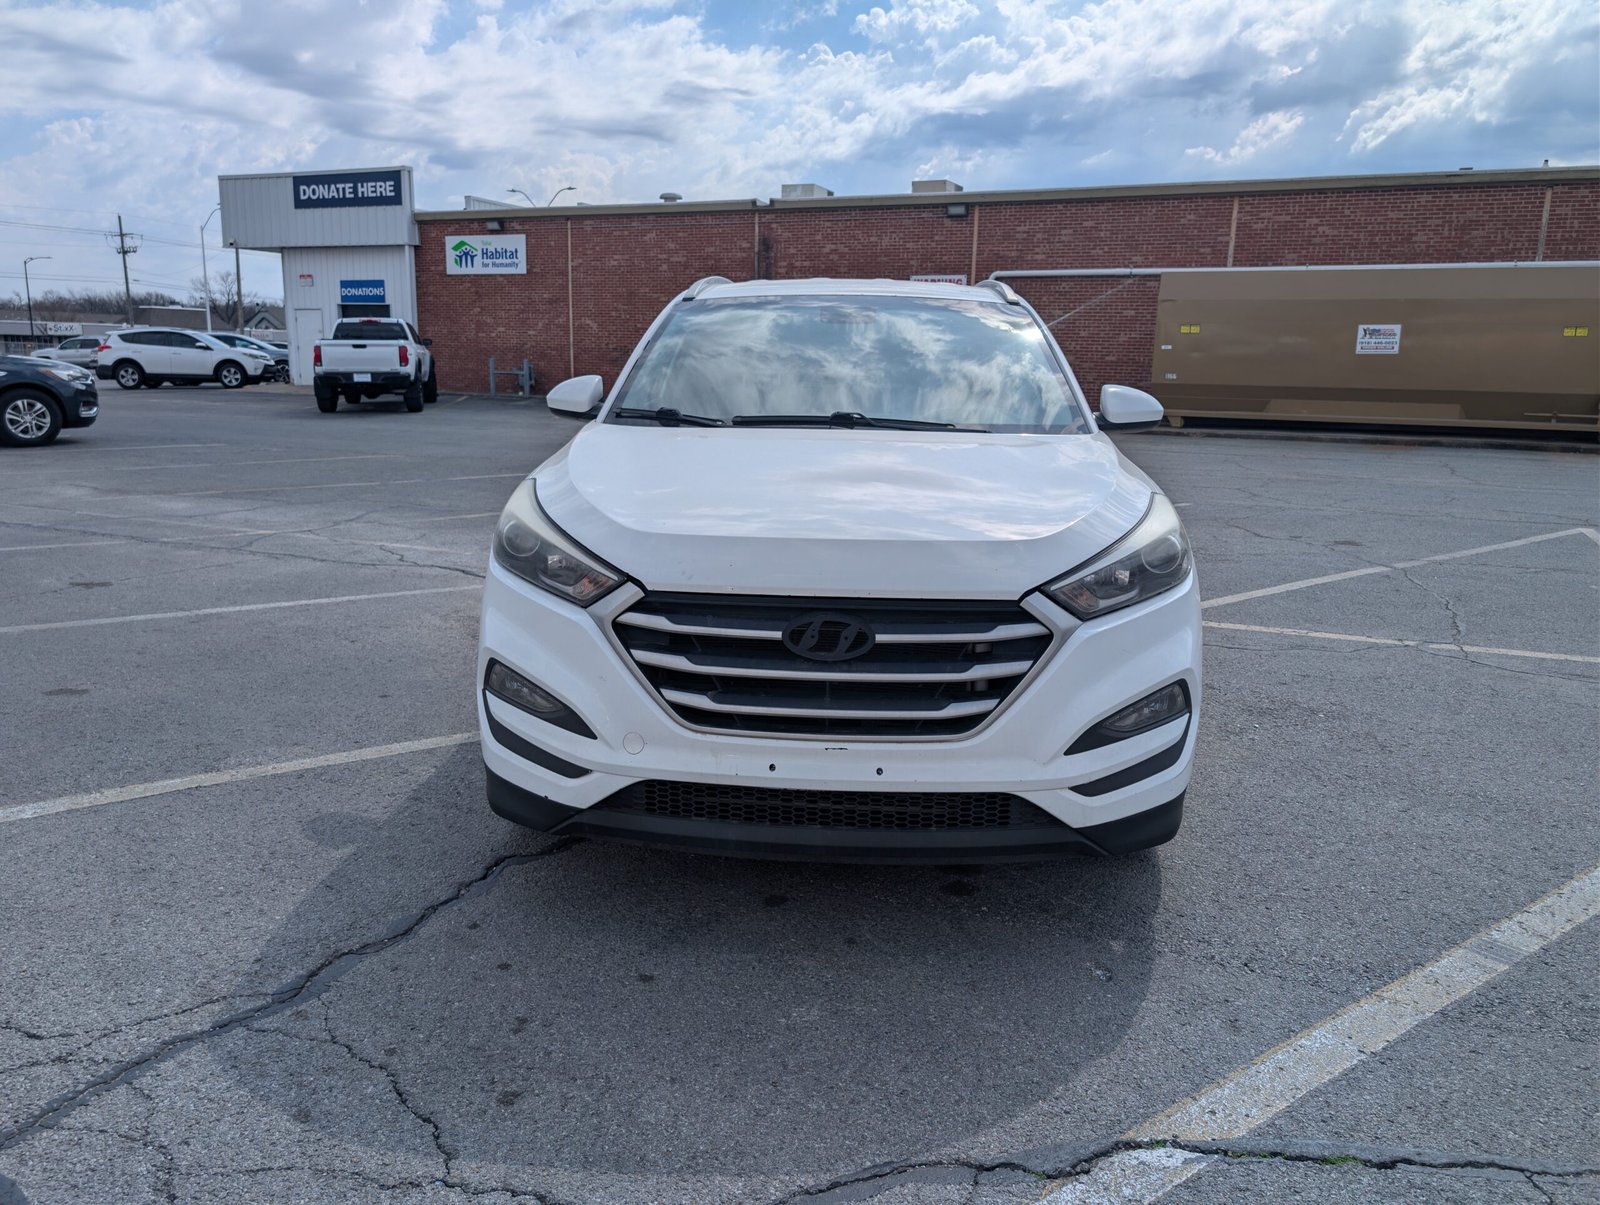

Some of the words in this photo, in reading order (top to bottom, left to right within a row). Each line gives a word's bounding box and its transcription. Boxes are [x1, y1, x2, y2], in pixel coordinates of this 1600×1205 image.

[299, 183, 354, 200] DONATE
[358, 181, 395, 198] HERE
[481, 247, 519, 260] Habitat
[491, 261, 519, 270] Humanity
[341, 287, 385, 296] DONATIONS
